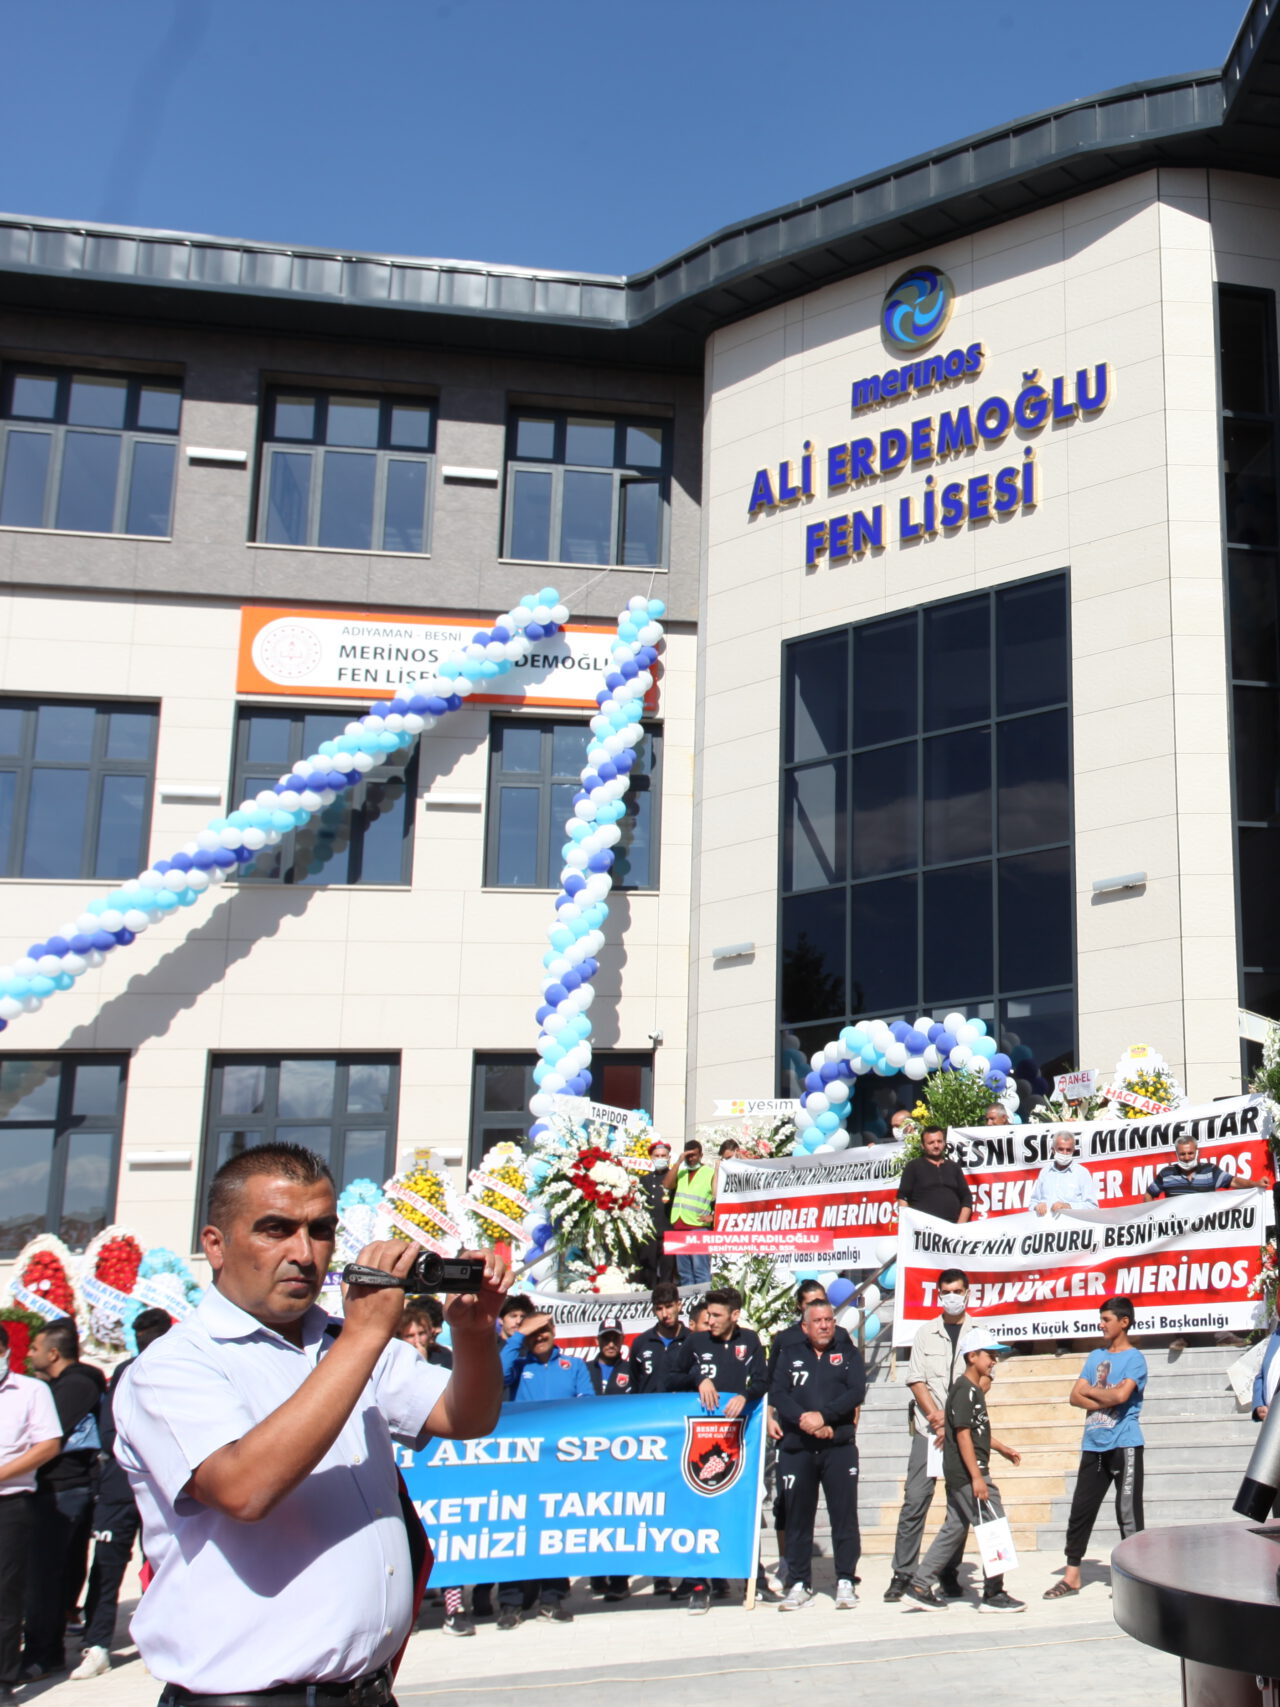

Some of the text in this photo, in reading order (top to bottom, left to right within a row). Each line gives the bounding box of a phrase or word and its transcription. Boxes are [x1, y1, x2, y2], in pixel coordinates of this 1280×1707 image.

[852, 342, 985, 410] merinos
[748, 361, 1112, 514] ALİ ERDEMOĞLU
[805, 445, 1038, 566] FEN LİSESİ
[341, 626, 414, 640] ADIYAMAN
[424, 629, 462, 642] BESNİ
[338, 643, 439, 663] MERİNOS
[337, 666, 379, 683] FEN
[702, 1235, 749, 1244] RIDVAN
[751, 1231, 819, 1244] FADILOĞLU
[1021, 1229, 1098, 1255] GURURU,
[1191, 1207, 1255, 1232] ONURU
[1115, 1256, 1249, 1294] MERİNOS
[987, 1323, 1028, 1337] erinos
[1032, 1321, 1069, 1337] Küçük
[1159, 1313, 1229, 1331] Başkanlığı
[645, 1361, 653, 1374] 5
[700, 1364, 717, 1379] 23
[792, 1371, 809, 1385] 77
[427, 1437, 544, 1467] AKIN
[556, 1435, 668, 1462] SPOR
[538, 1491, 666, 1518] TAKIMI
[538, 1521, 720, 1556] BEKLİYOR
